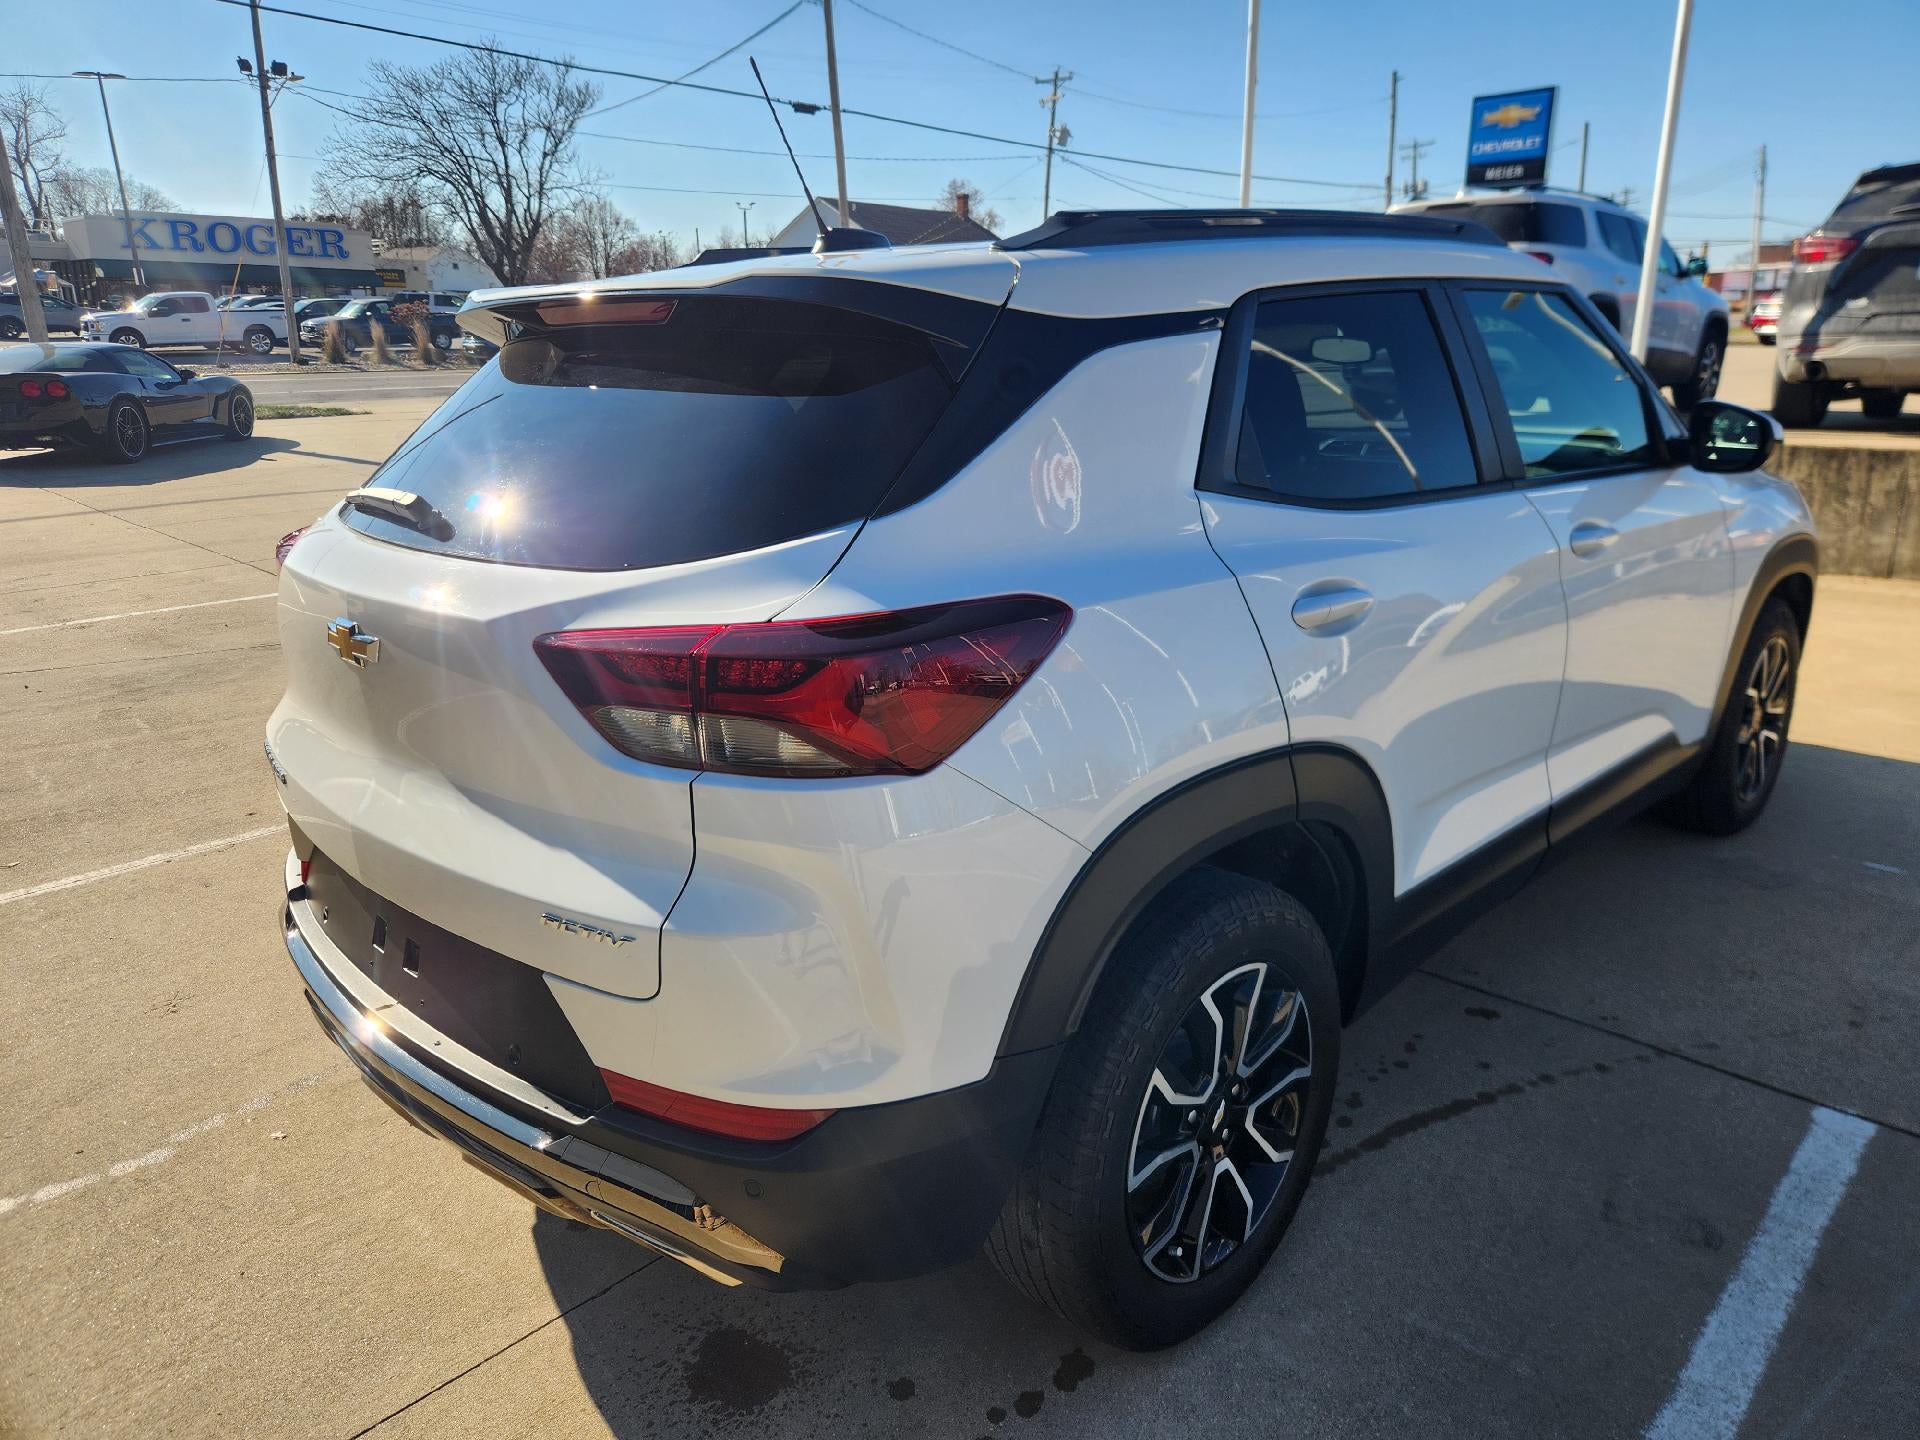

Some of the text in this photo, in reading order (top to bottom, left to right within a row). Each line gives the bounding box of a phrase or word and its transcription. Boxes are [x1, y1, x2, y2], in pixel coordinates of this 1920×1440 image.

[1472, 136, 1542, 155] CHEVROLET
[1484, 164, 1524, 180] MEIER
[118, 217, 350, 260] KROGER
[541, 912, 637, 950] ACTIV
